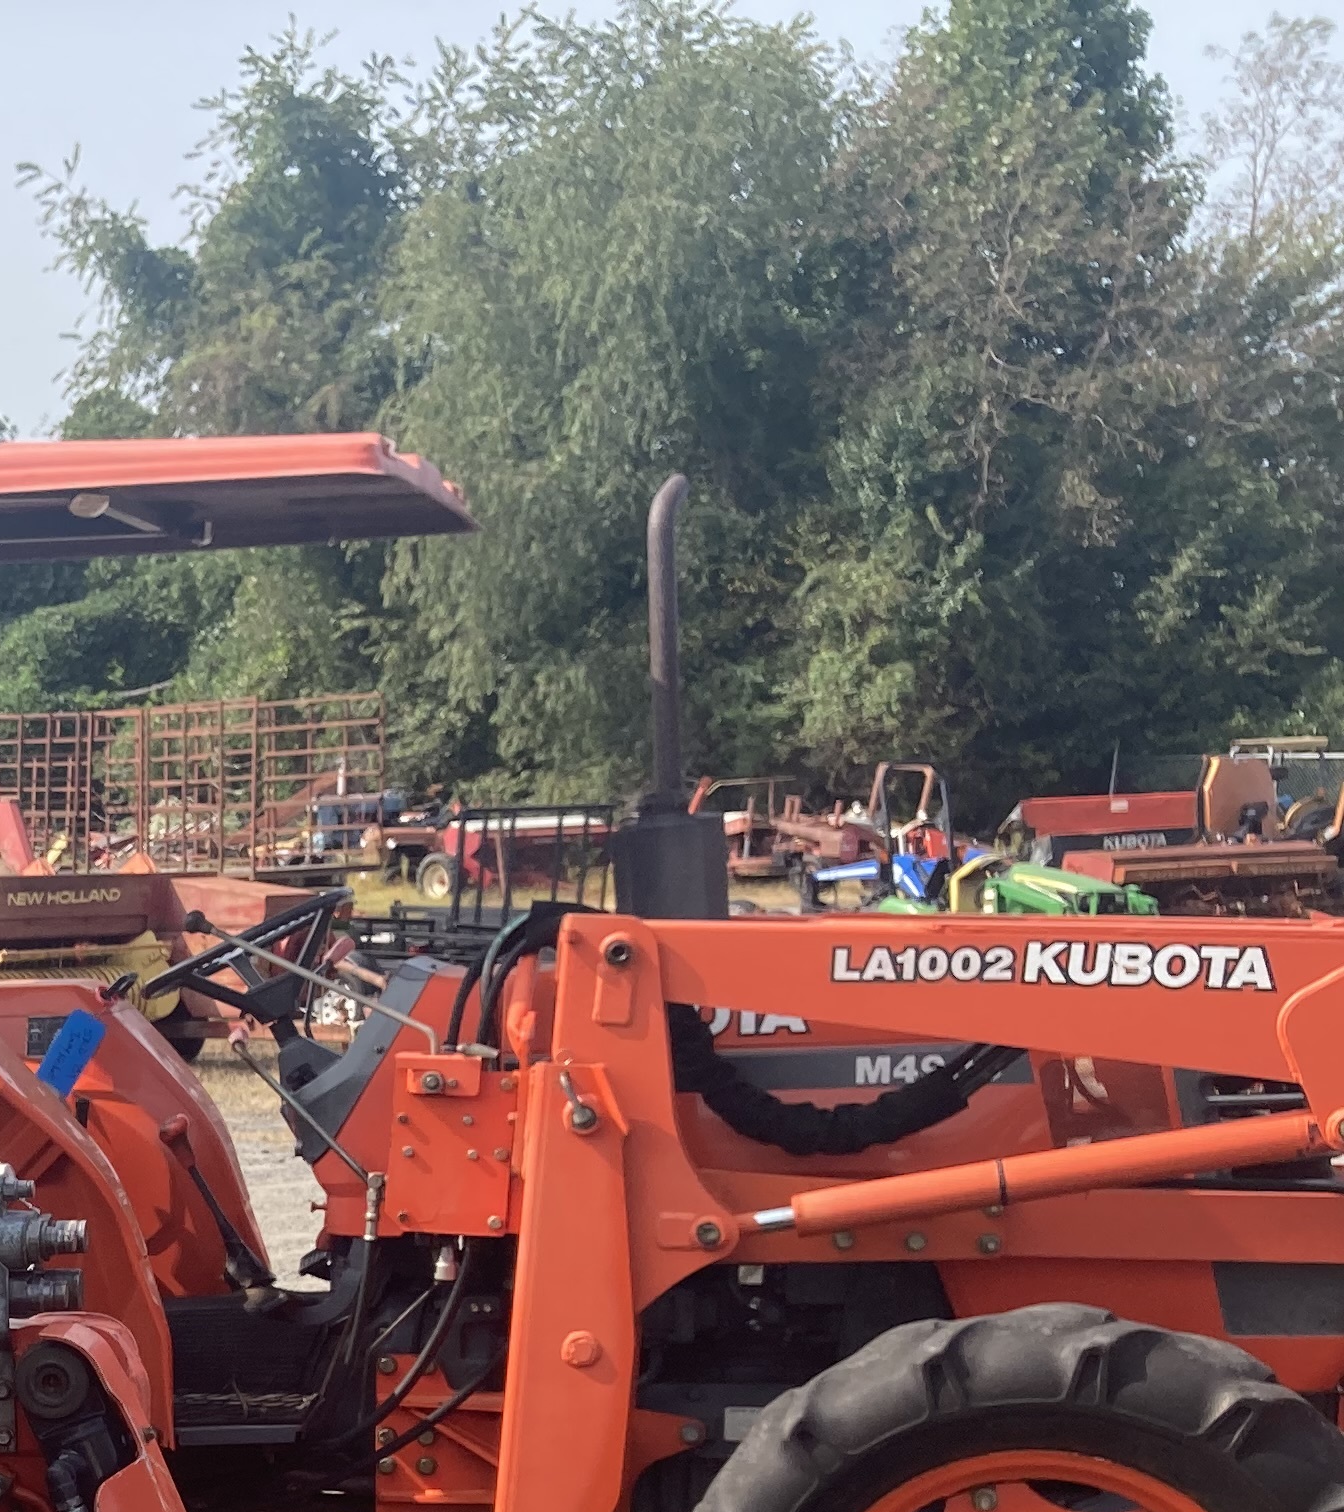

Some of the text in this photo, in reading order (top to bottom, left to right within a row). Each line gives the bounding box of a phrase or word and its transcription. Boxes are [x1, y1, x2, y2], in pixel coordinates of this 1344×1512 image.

[7, 887, 121, 907] NEW HOLLAND
[832, 941, 1277, 992] LA1002 KUBOTA
